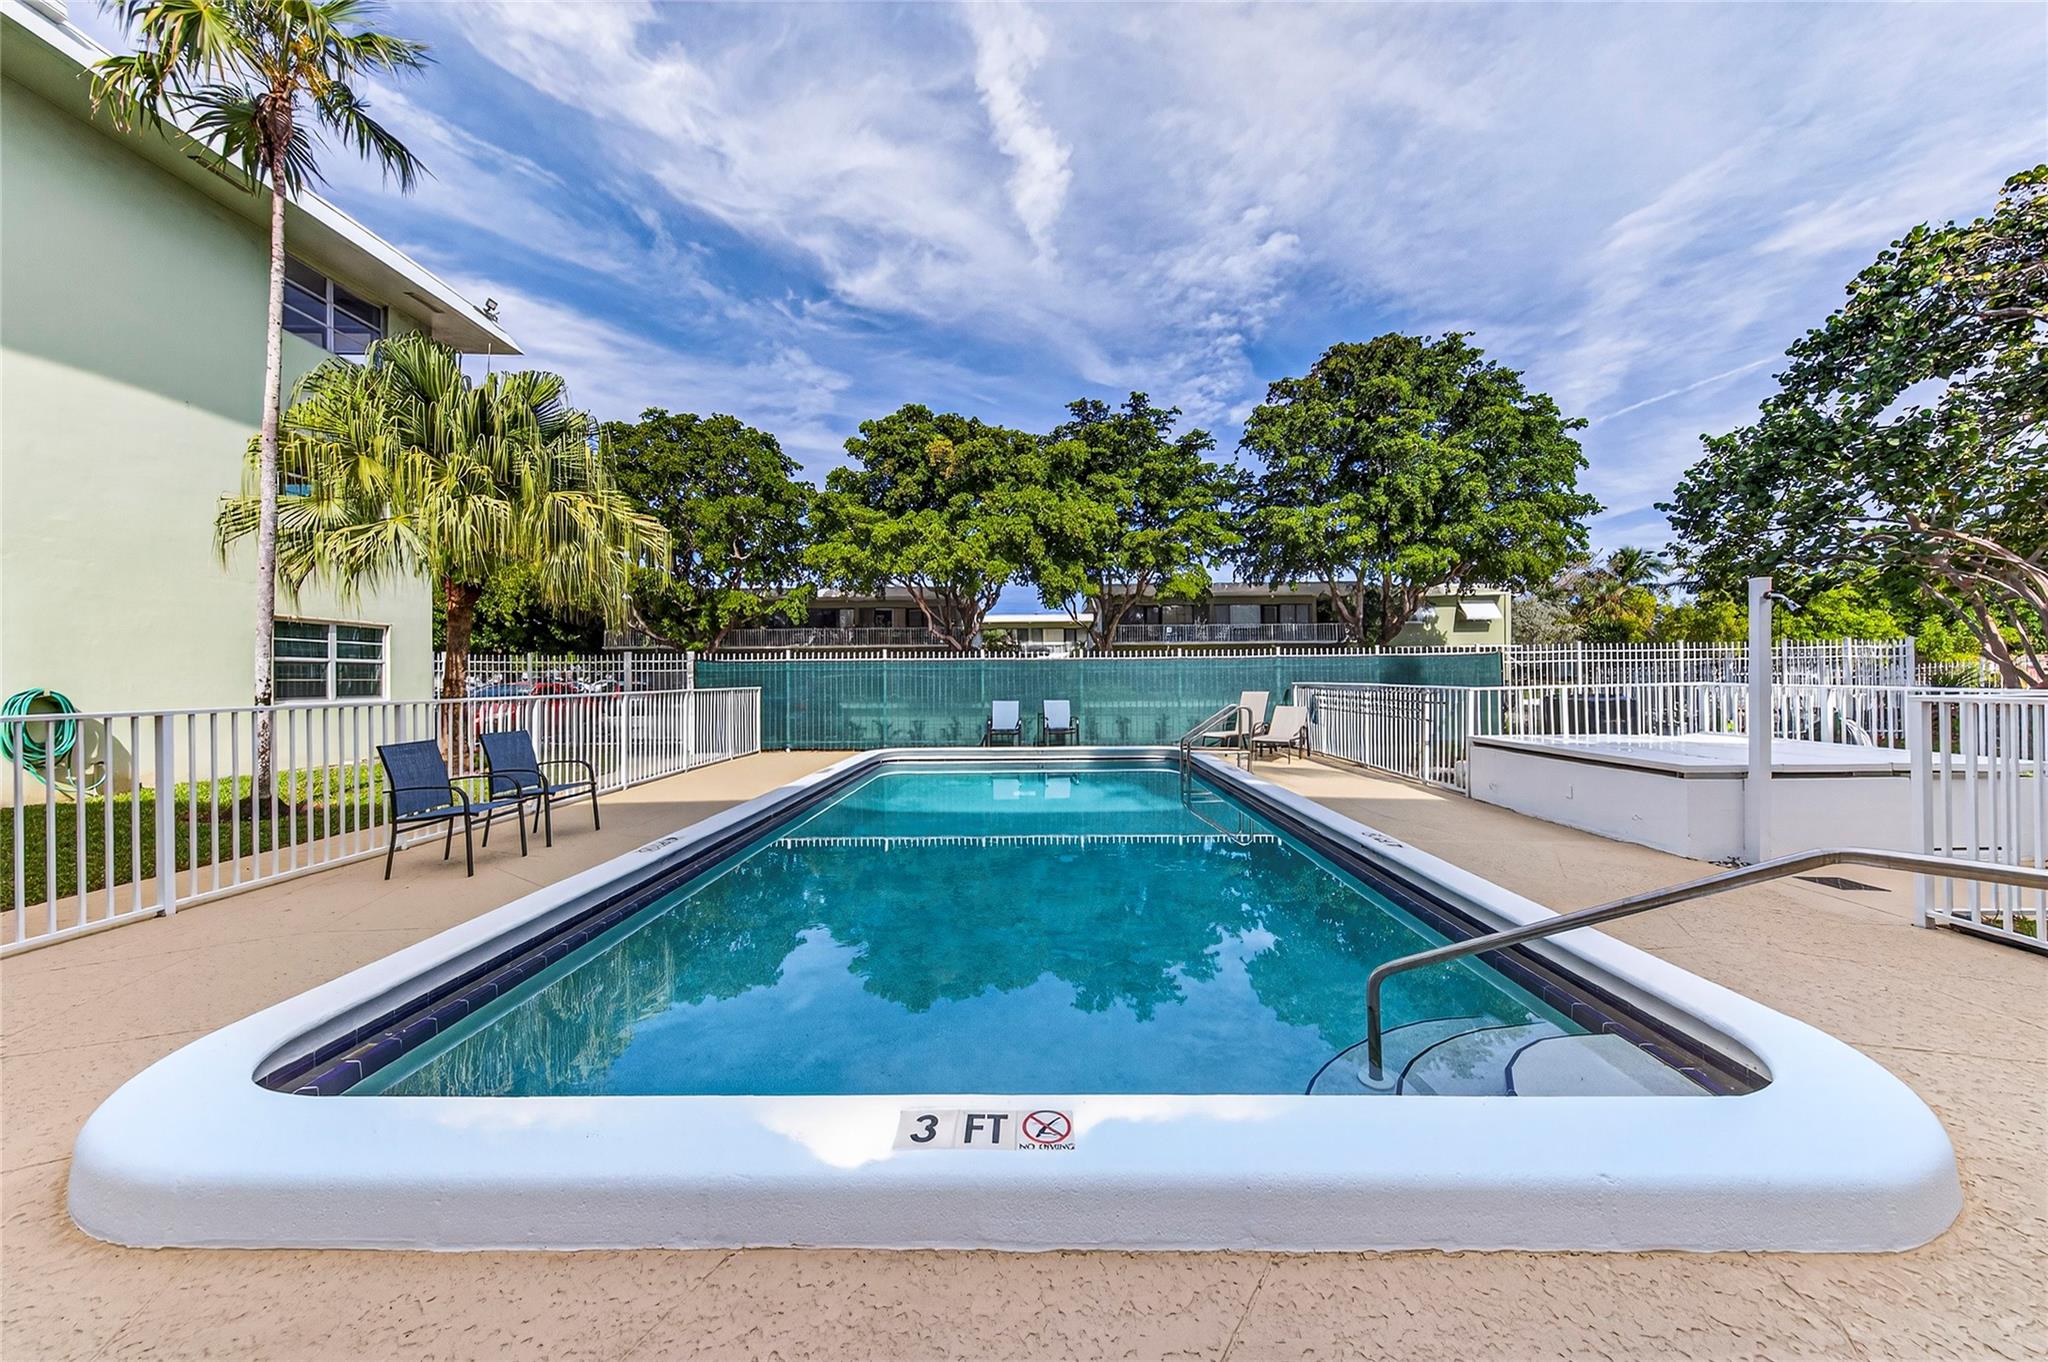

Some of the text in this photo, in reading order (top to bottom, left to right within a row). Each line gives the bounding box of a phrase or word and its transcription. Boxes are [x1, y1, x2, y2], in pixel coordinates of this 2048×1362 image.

[909, 1113, 1009, 1144] 3 FT
[1038, 1143, 1076, 1151] DIVING
